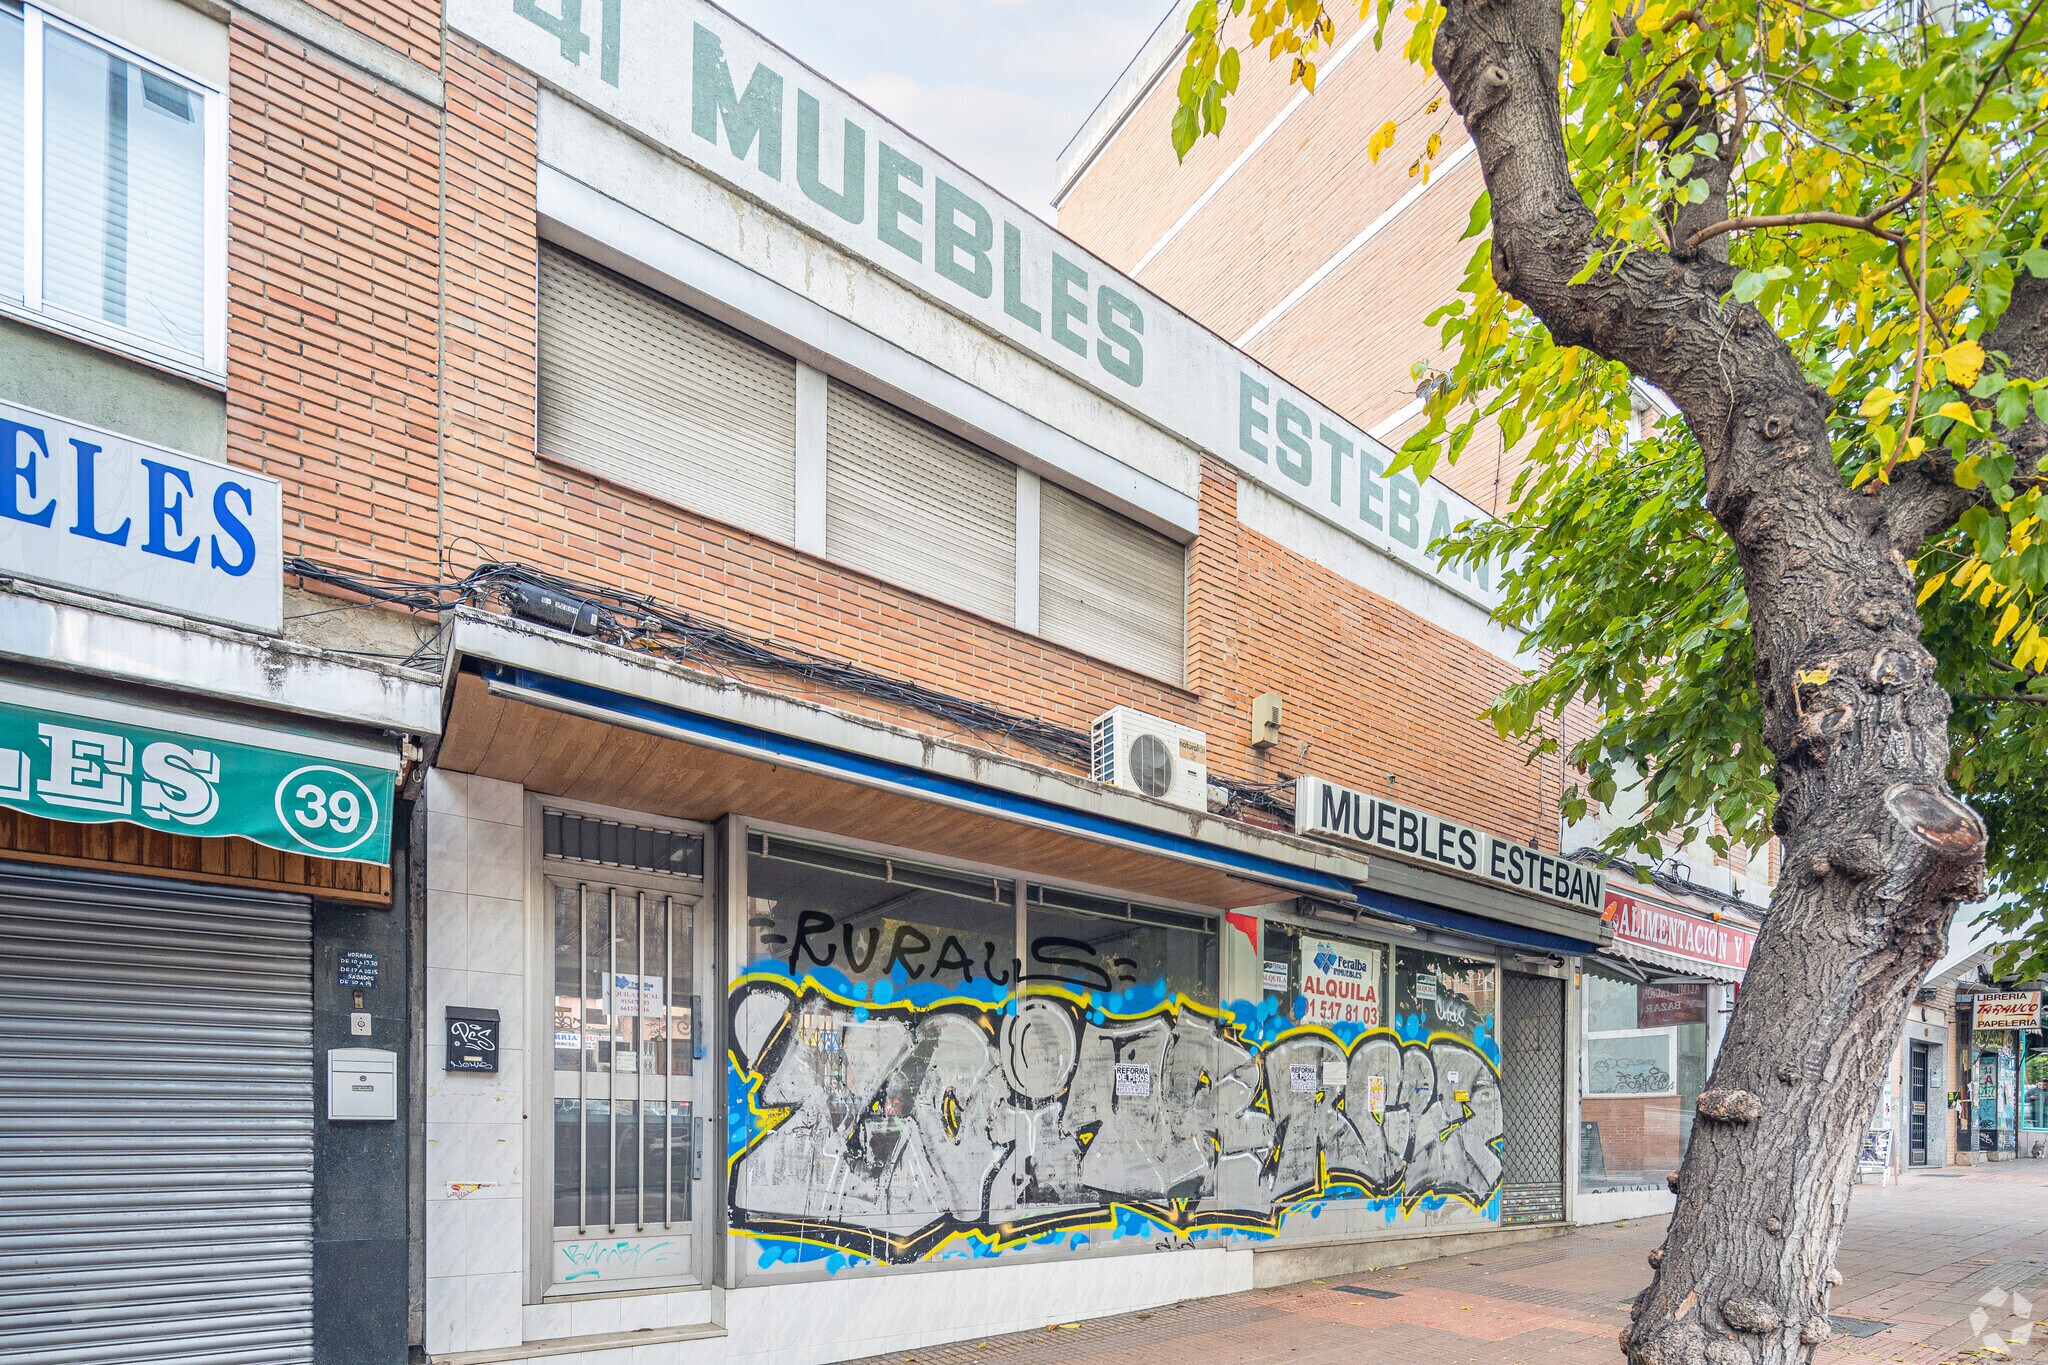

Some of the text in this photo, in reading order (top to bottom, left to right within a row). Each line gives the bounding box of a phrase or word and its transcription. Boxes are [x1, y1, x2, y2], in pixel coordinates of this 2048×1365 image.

[692, 21, 1144, 388] MUEBLES
[0, 417, 256, 577] ELES
[294, 784, 360, 833] 39
[1321, 783, 1601, 908] MUEBLES ESTEBAN
[1619, 903, 1728, 961] ALIMENTACION
[1733, 935, 1744, 964] Y
[1333, 968, 1363, 980] INMUEBLES
[1337, 955, 1367, 972] Feralba
[1303, 975, 1377, 1003] ALQUILA
[1977, 992, 2027, 1002] LIBRERIA
[1345, 1003, 1359, 1022] 81
[1363, 1007, 1378, 1025] 03
[1976, 1003, 2039, 1016] TARANCO
[1977, 1019, 2038, 1028] PAPELERIA
[1116, 1066, 1149, 1075] REFORMA
